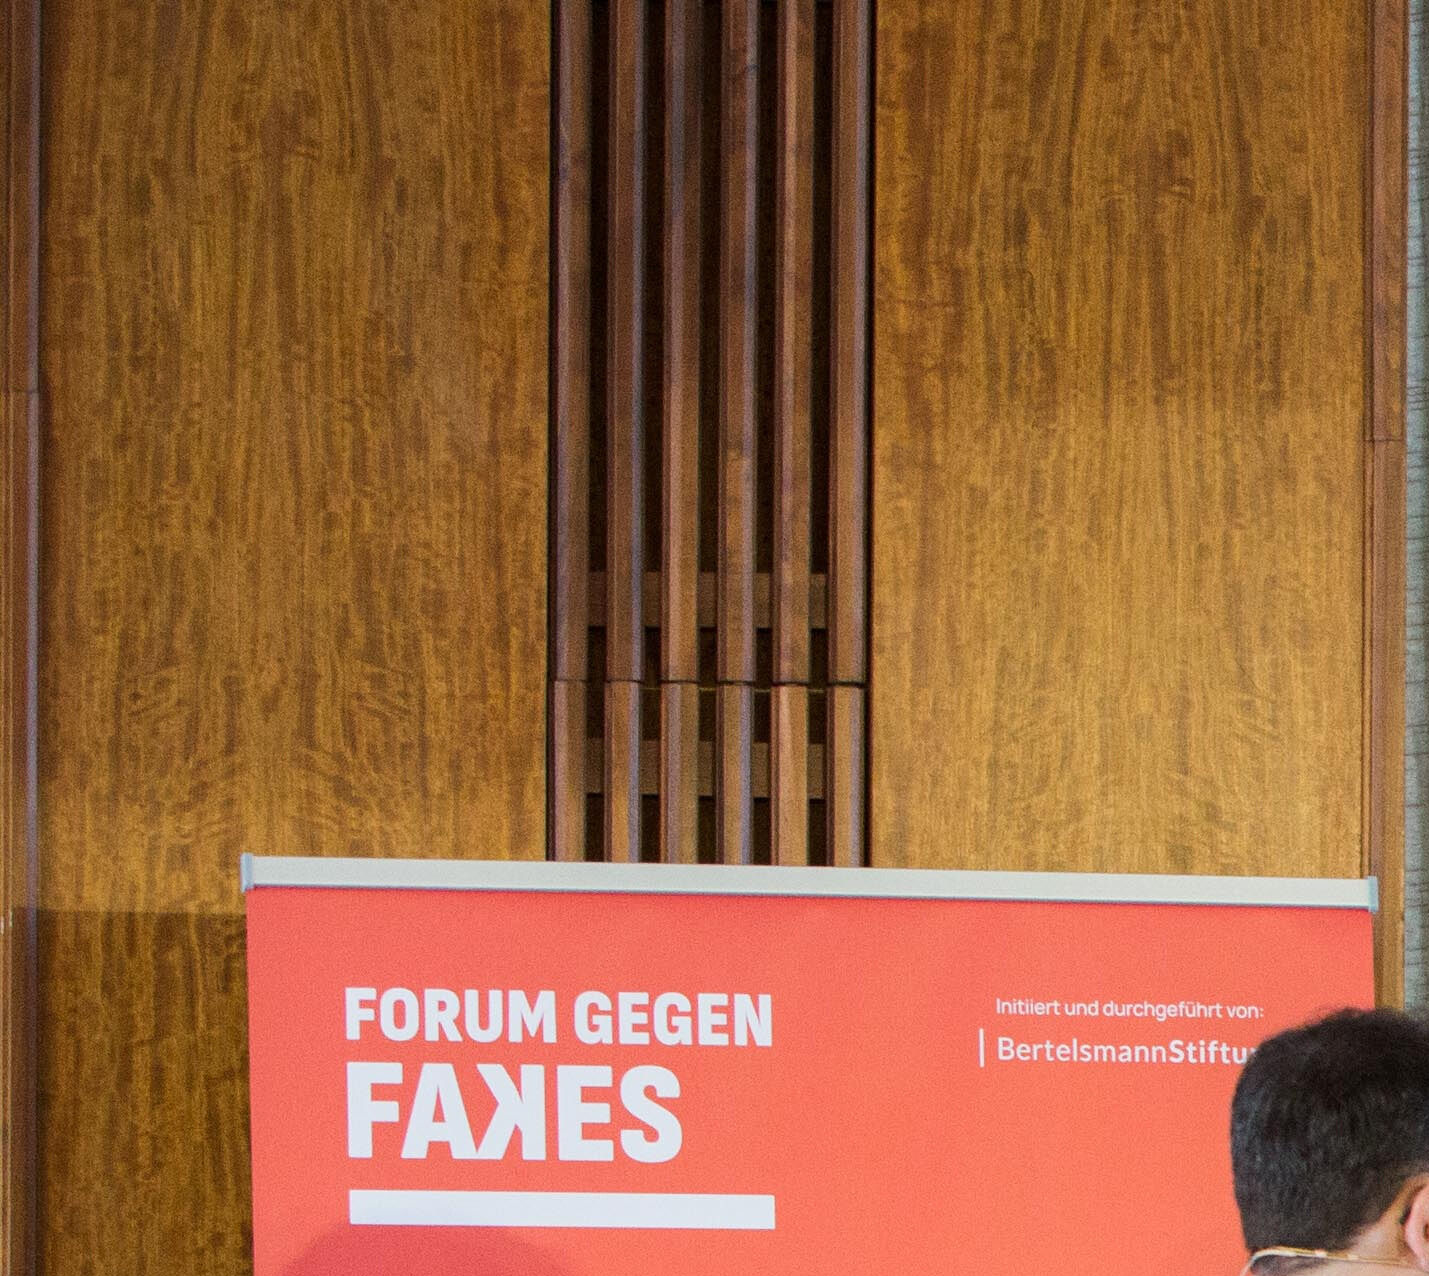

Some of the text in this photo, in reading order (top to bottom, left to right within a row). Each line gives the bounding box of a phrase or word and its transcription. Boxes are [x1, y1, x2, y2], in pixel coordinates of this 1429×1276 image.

[345, 986, 774, 1048] FORUM GEGEN
[996, 998, 1264, 1023] Initiiert und durchgeführt von:
[997, 1036, 1258, 1065] BertelsmannStiftu
[346, 1060, 684, 1166] FAKES
